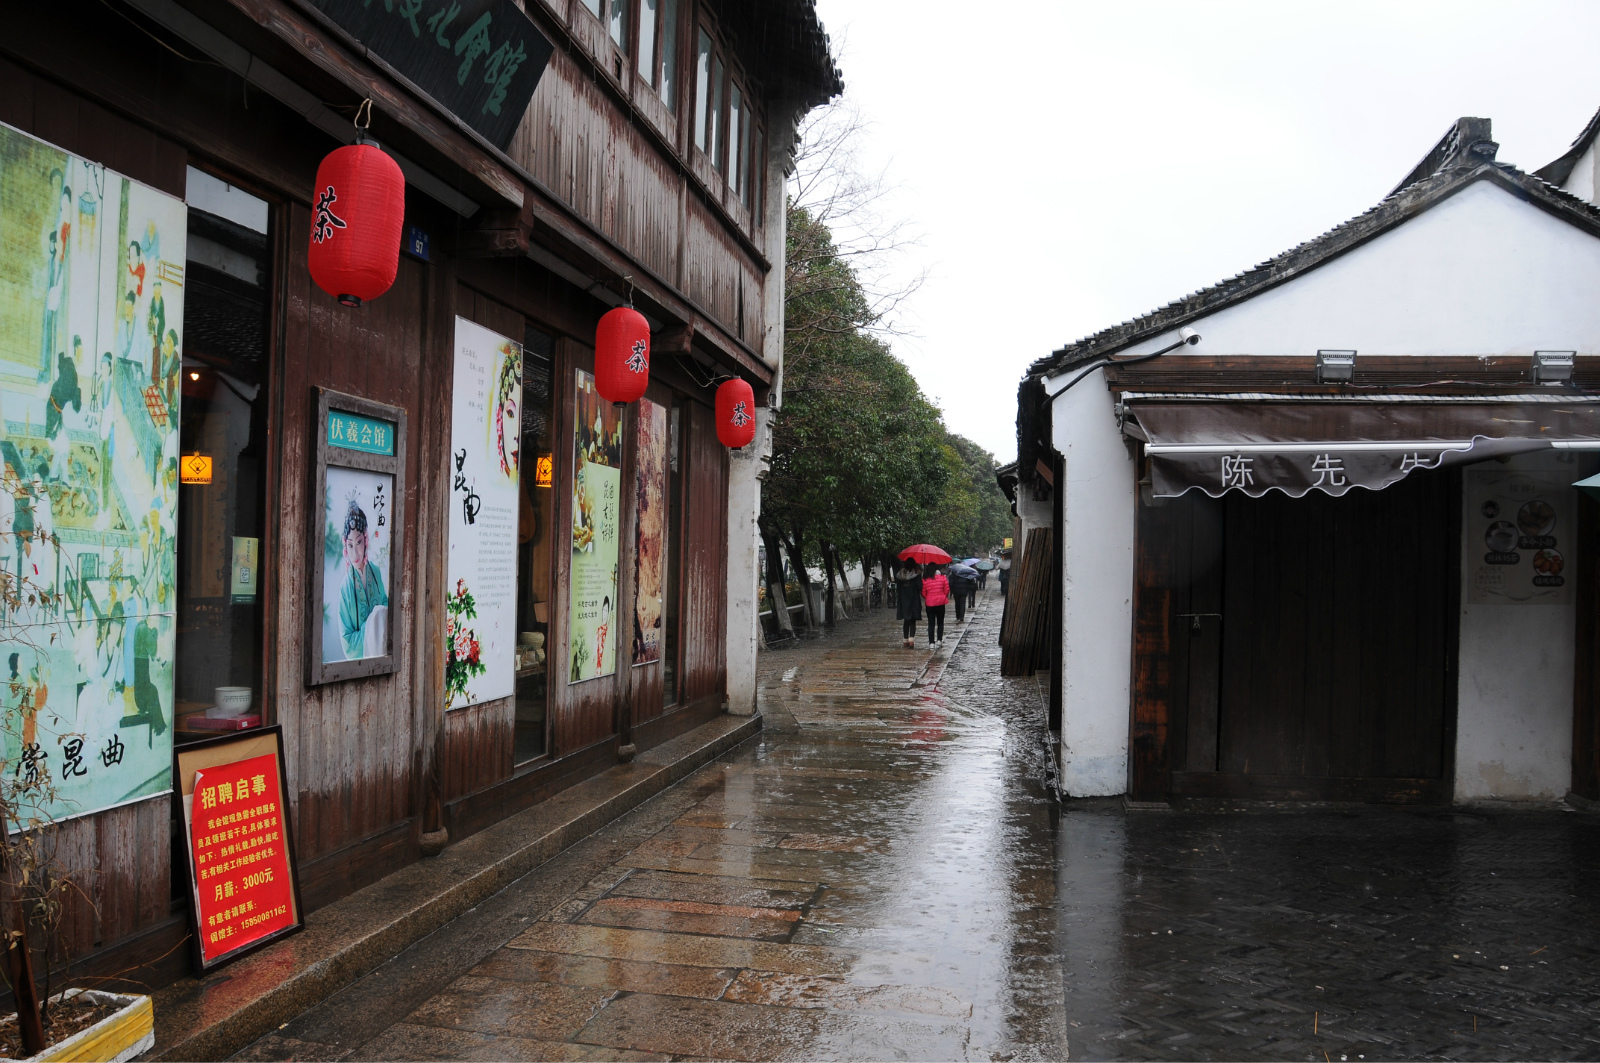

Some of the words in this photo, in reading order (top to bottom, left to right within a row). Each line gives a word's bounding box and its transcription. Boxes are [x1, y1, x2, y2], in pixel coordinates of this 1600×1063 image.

[312, 186, 347, 244] 茶
[415, 239, 424, 255] 97
[625, 339, 649, 374] 茶
[330, 416, 386, 448] 伏羲会馆
[730, 401, 752, 428] 茶
[453, 448, 481, 526] 昆曲
[373, 482, 386, 528] 昆曲
[201, 774, 267, 810] 招聘启事
[207, 802, 276, 830] 我会馆现急需全职服务
[214, 867, 274, 902] 月薪：3000元
